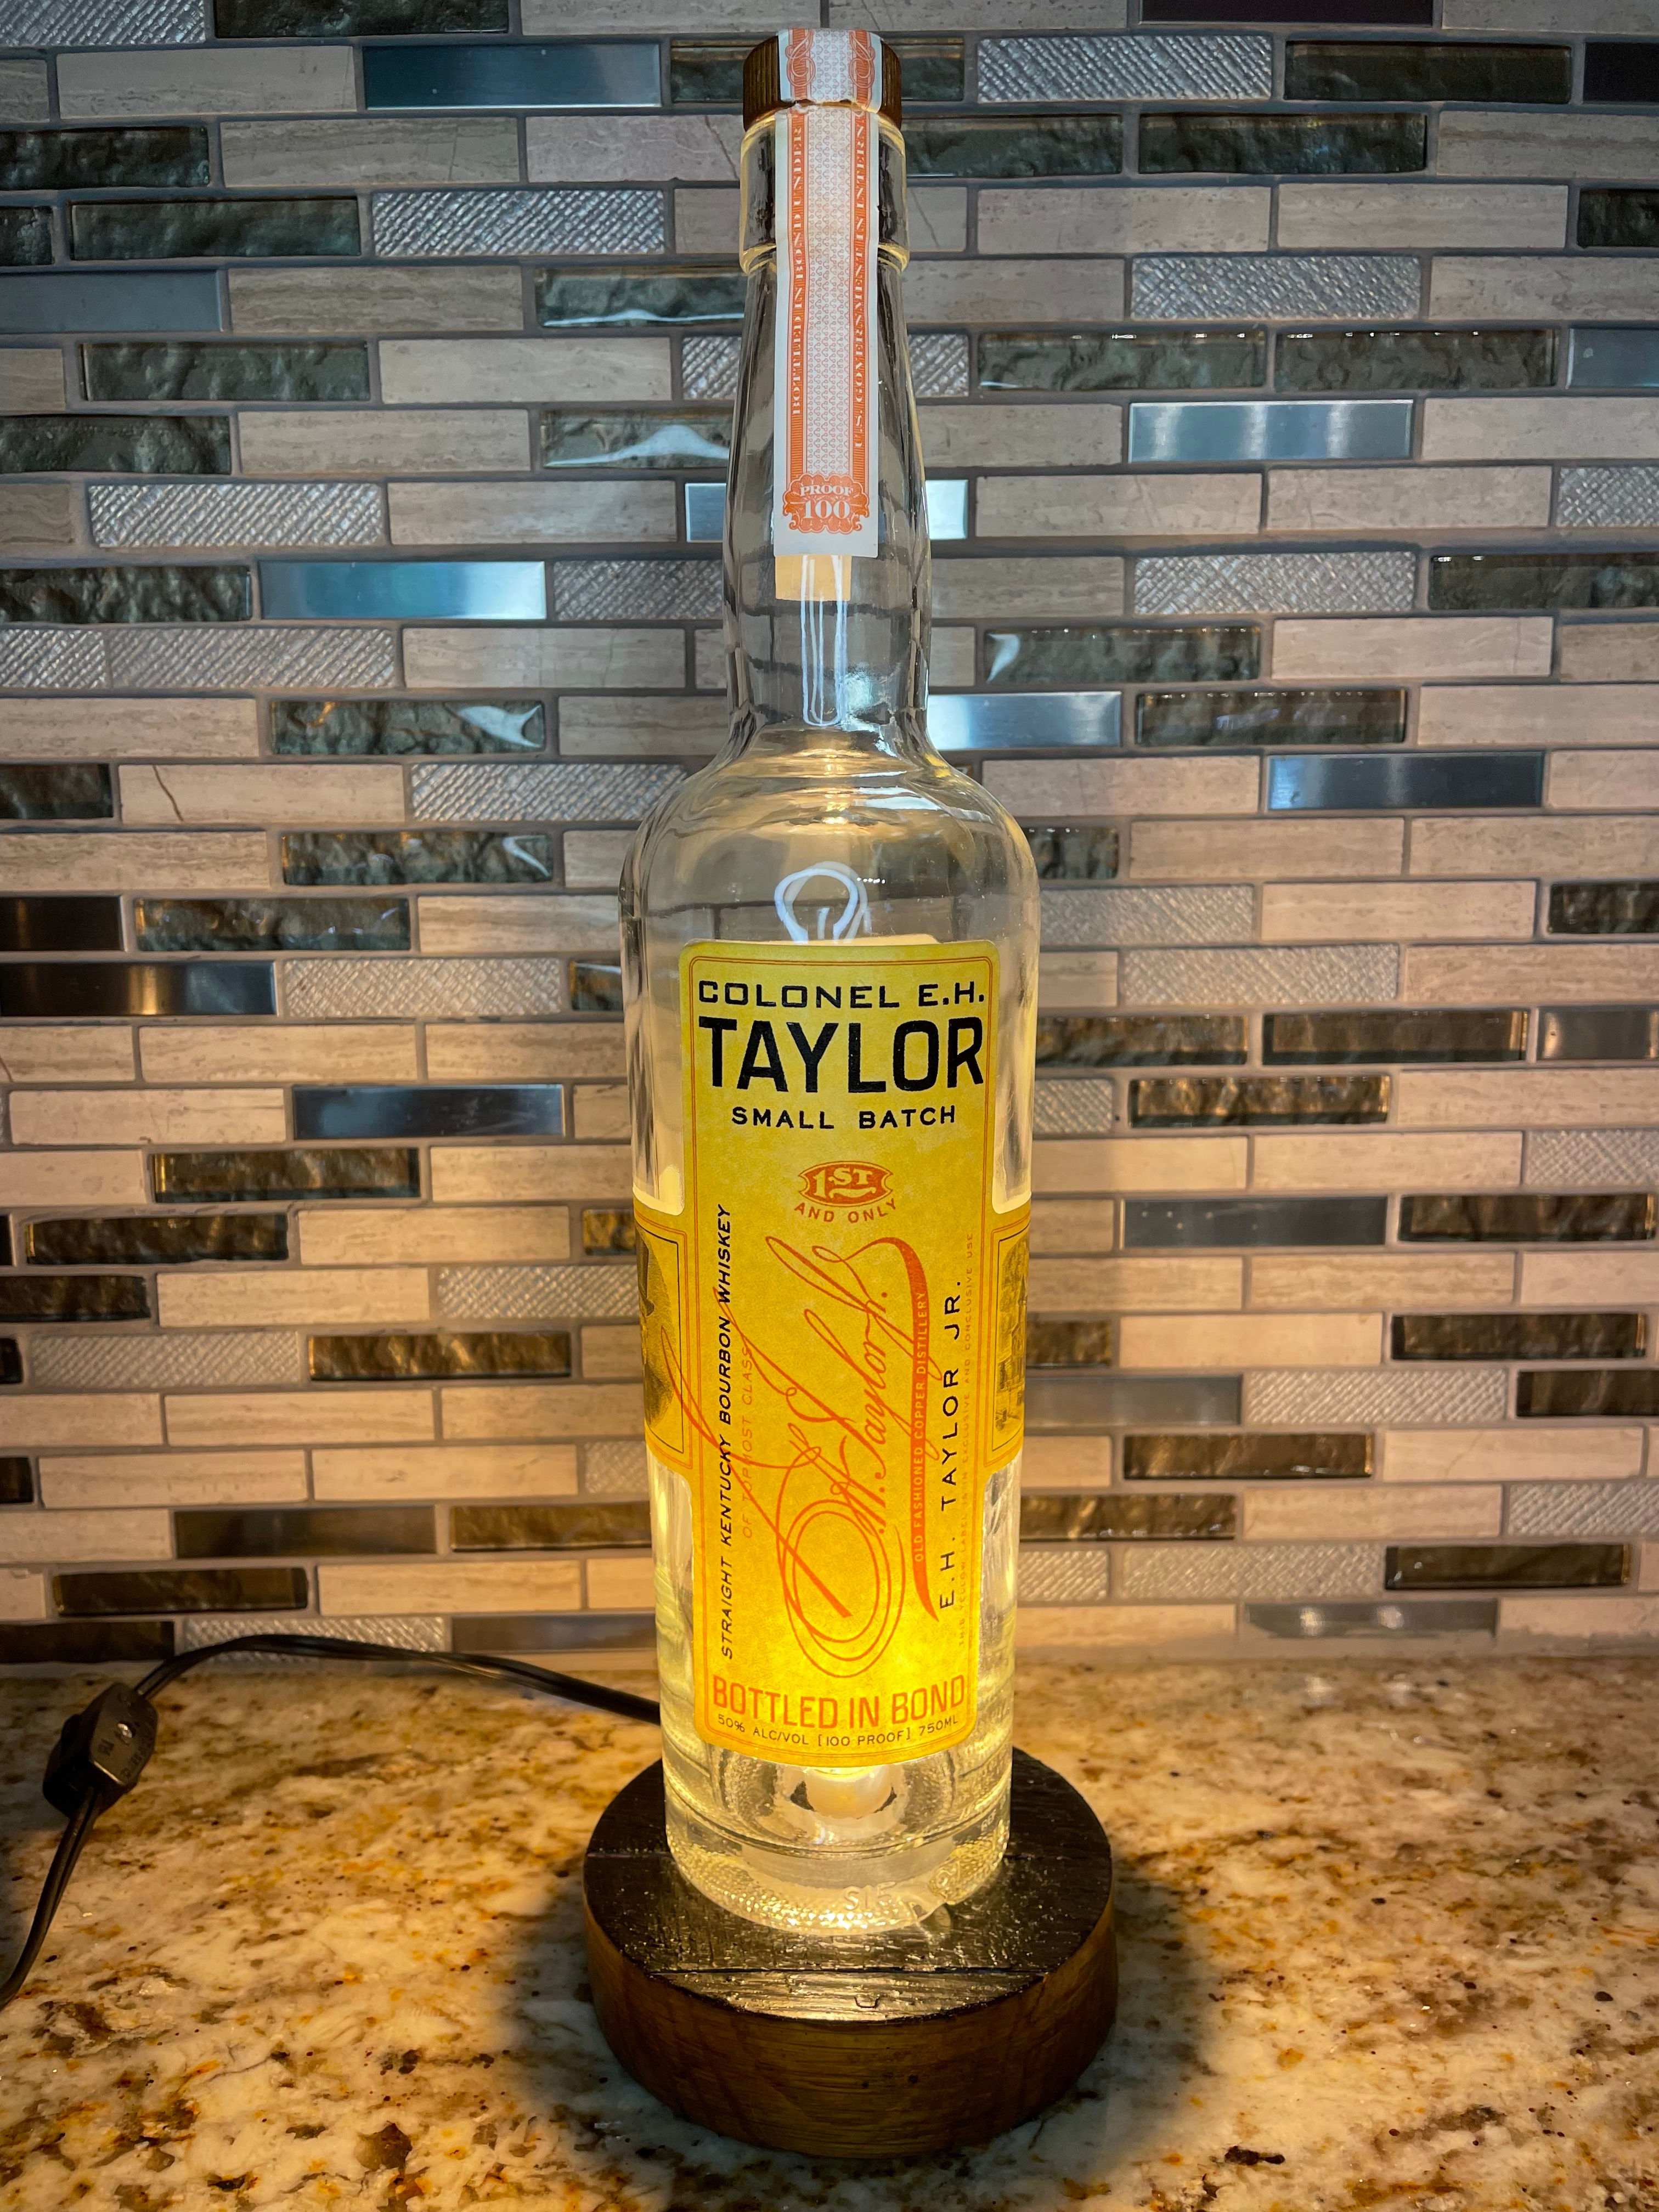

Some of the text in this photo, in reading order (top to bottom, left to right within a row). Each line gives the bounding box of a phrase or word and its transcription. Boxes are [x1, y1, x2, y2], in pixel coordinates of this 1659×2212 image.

[793, 128, 803, 414] BOTTLED IN BOND UNDER
[854, 246, 865, 402] GOVERNMENT
[799, 484, 854, 496] PROOF
[804, 500, 850, 519] 100
[698, 980, 985, 1008] COLONEL E.H.
[698, 1015, 984, 1093] TAYLOR
[731, 1105, 956, 1129] SMALL BATCH
[794, 1198, 896, 1223] AND ONLY
[812, 1167, 873, 1198] 1ST
[718, 1203, 733, 1660] STRAIGHT KENTUCKY BOURBON WHISKEY
[742, 1347, 753, 1539] OF TOPMOST CLASS
[913, 1291, 927, 1562] OLD FASHIONED COPPER DISTILLERY
[940, 1282, 961, 1609] E.H. TAYLOR JR.
[962, 1393, 970, 1463] EXCLUSIVE
[713, 1674, 965, 1729] BOTTLED IN BOND
[718, 1713, 746, 1733] 50%
[752, 1726, 809, 1745] ALC/VOL
[918, 1714, 960, 1736] 750ML
